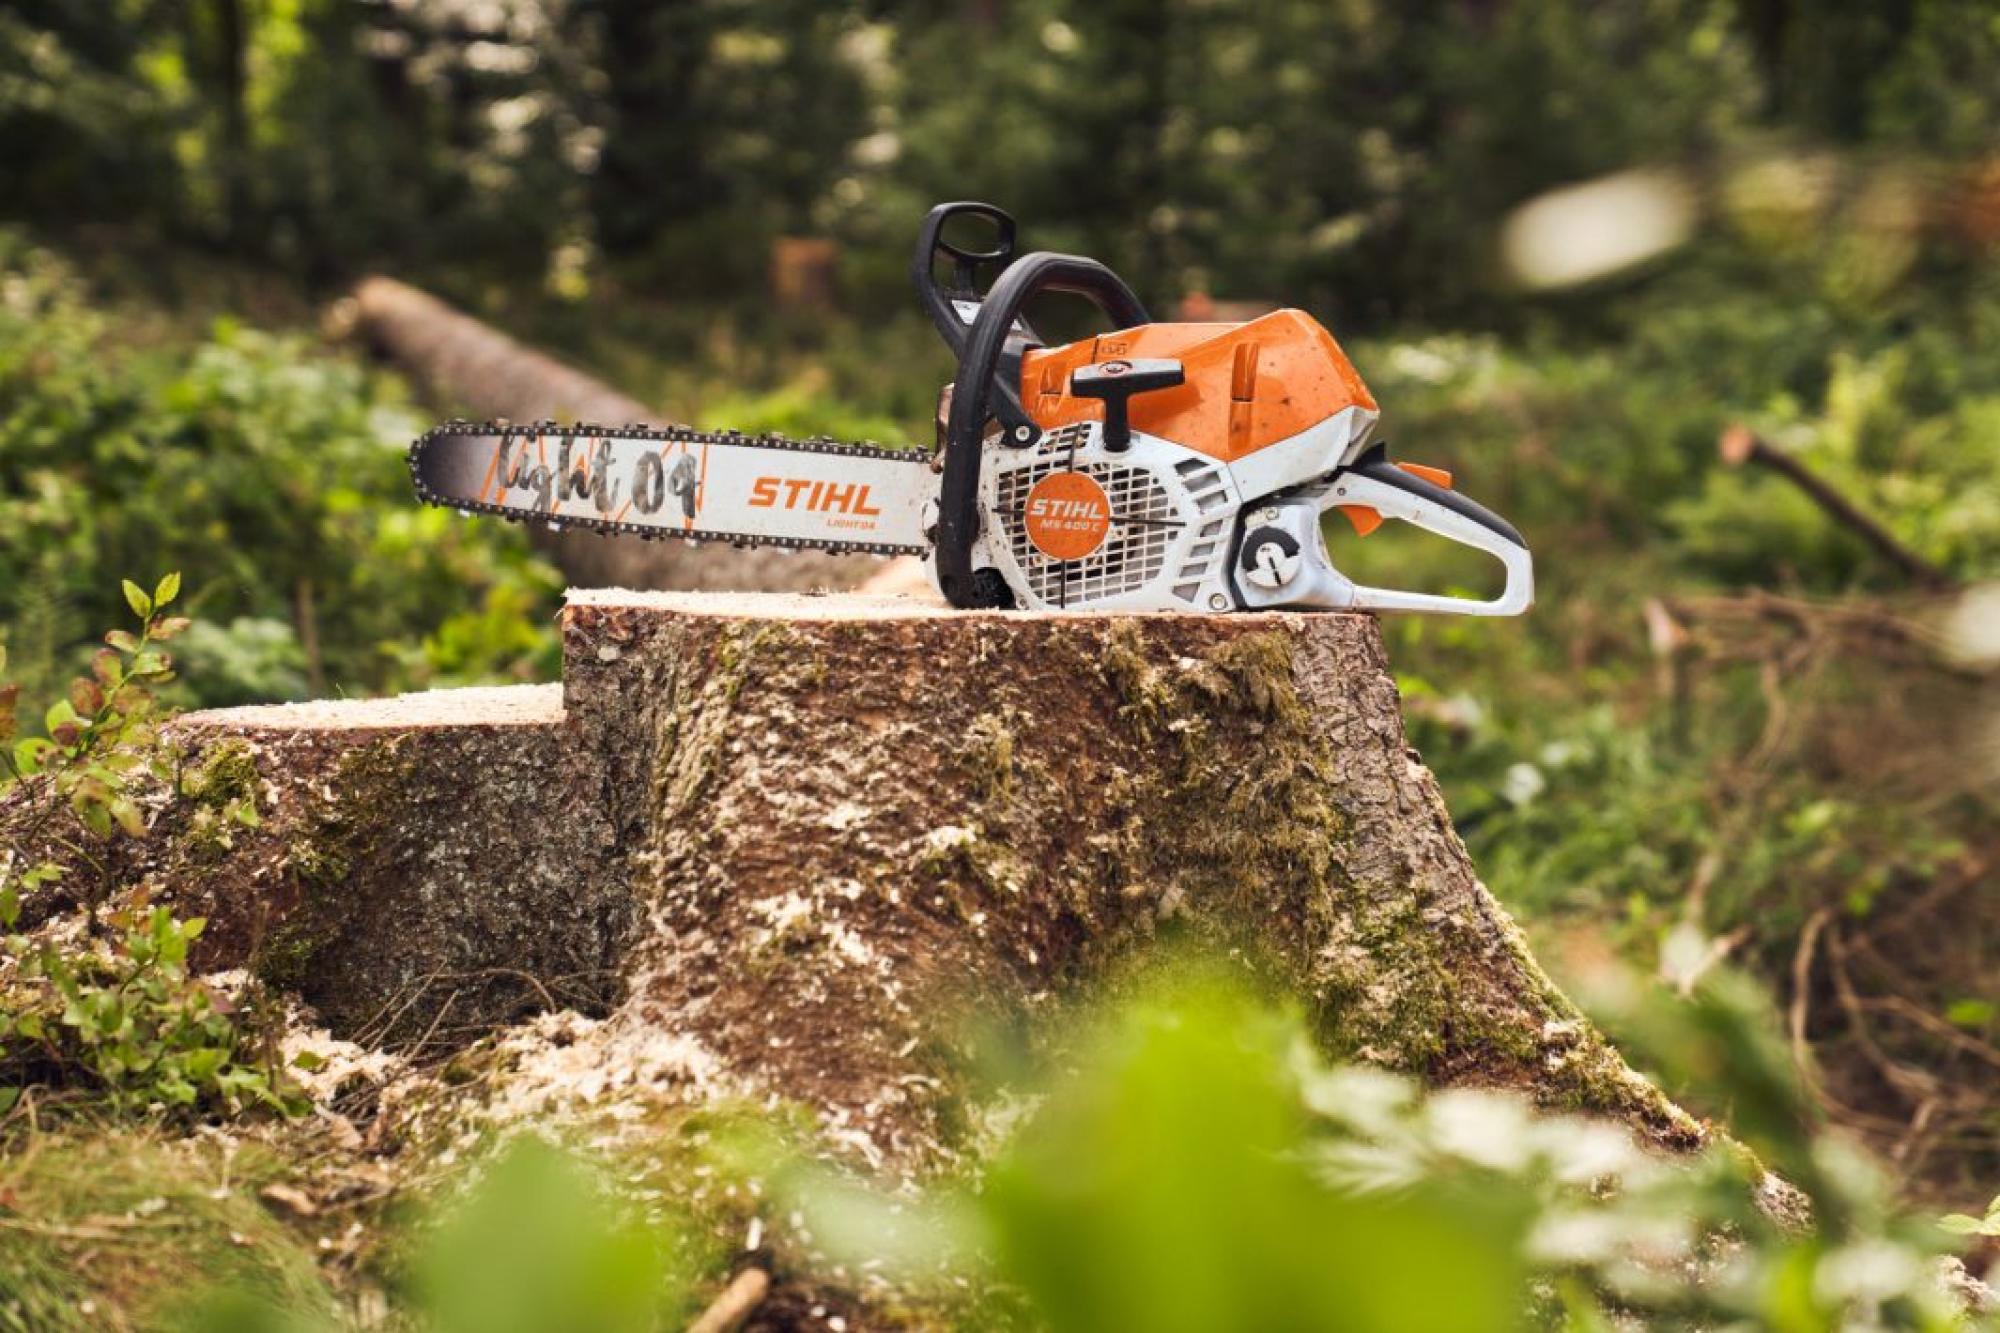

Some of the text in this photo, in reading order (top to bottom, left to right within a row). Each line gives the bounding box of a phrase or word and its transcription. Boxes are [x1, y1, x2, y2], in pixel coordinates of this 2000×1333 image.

[748, 477, 881, 516] STIHL
[1030, 498, 1105, 519] STIHL
[1041, 519, 1063, 530] MS
